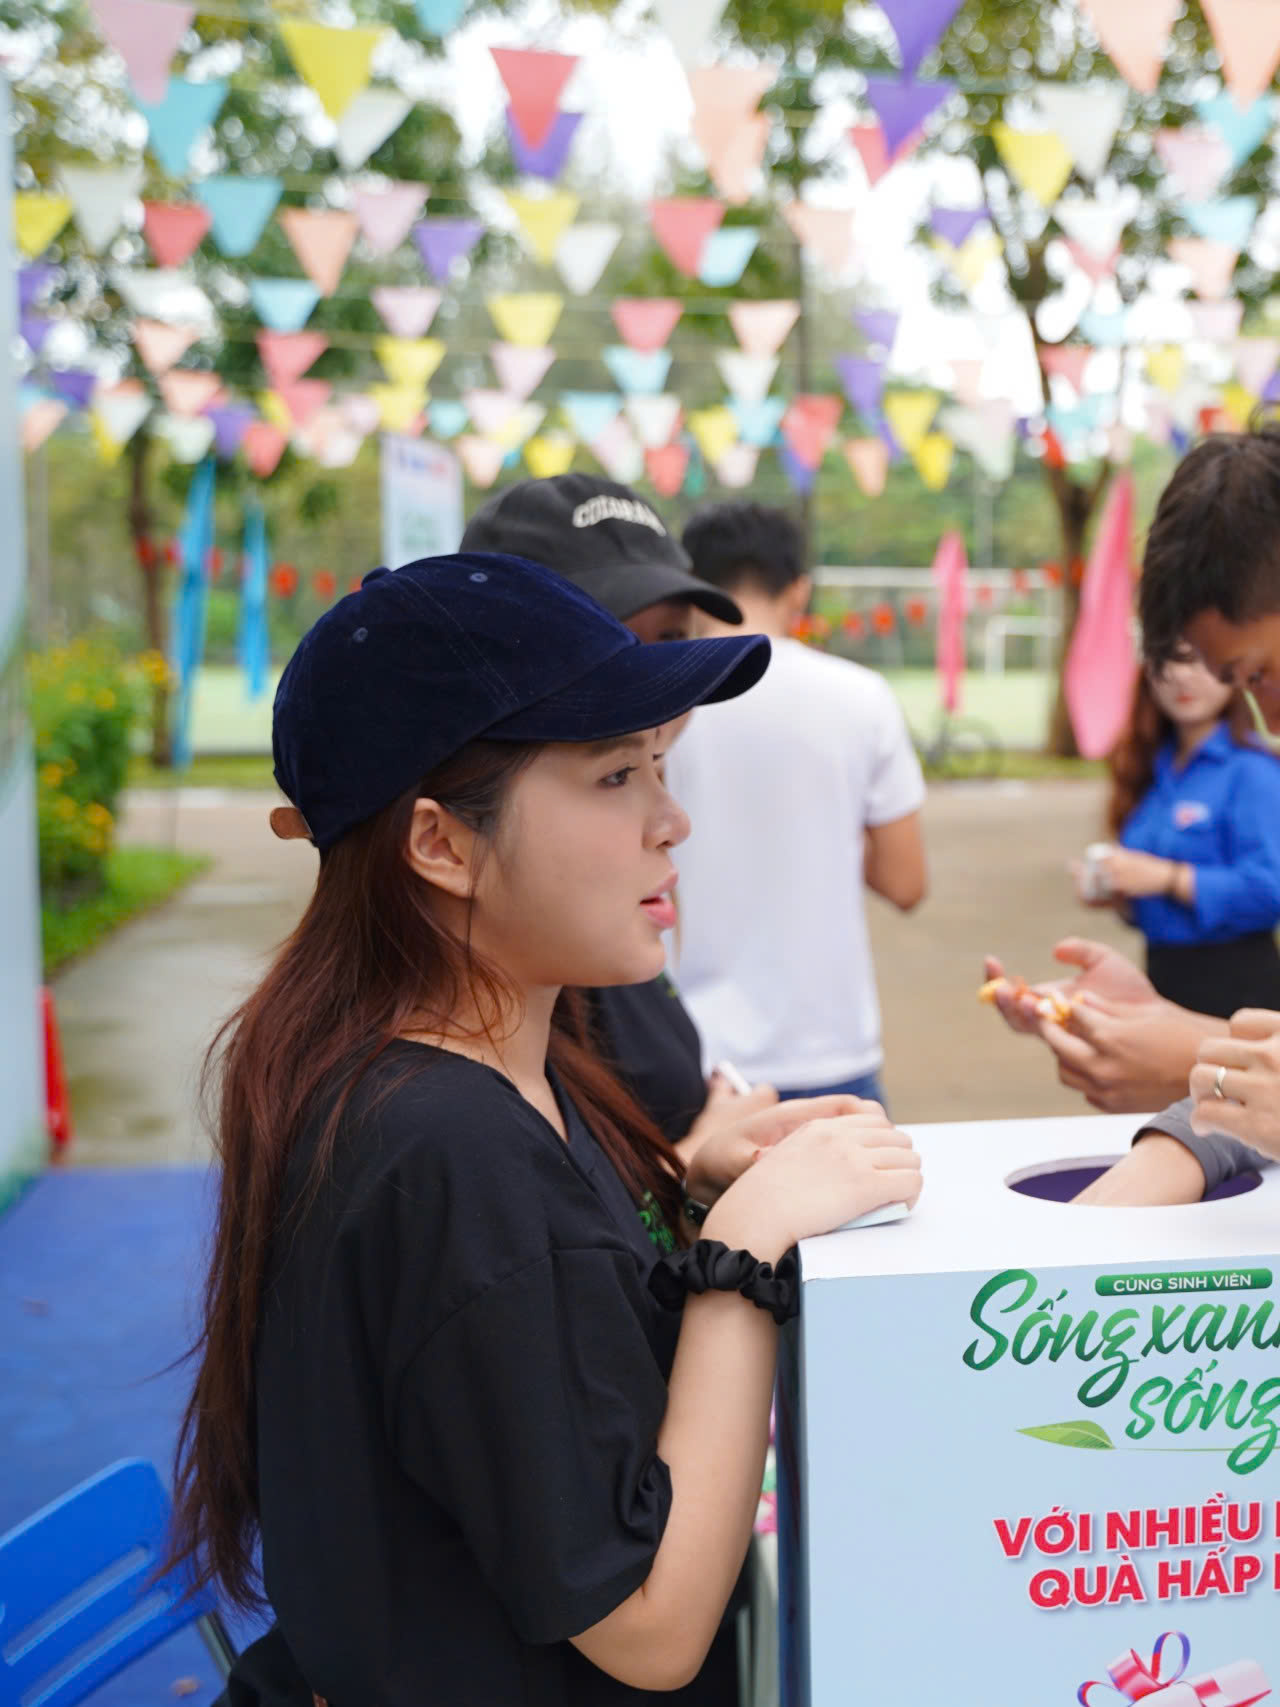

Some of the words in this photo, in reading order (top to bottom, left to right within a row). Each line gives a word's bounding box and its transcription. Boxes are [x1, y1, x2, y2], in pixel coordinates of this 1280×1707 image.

[1112, 1277, 1163, 1292] CÙNG
[1167, 1275, 1208, 1290] SINH
[1212, 1271, 1252, 1288] VIÊN
[994, 1506, 1092, 1558] VỚI
[1106, 1492, 1260, 1550] NHIỀU
[1029, 1560, 1144, 1609] QUÀ
[1157, 1545, 1262, 1600] HẤP
